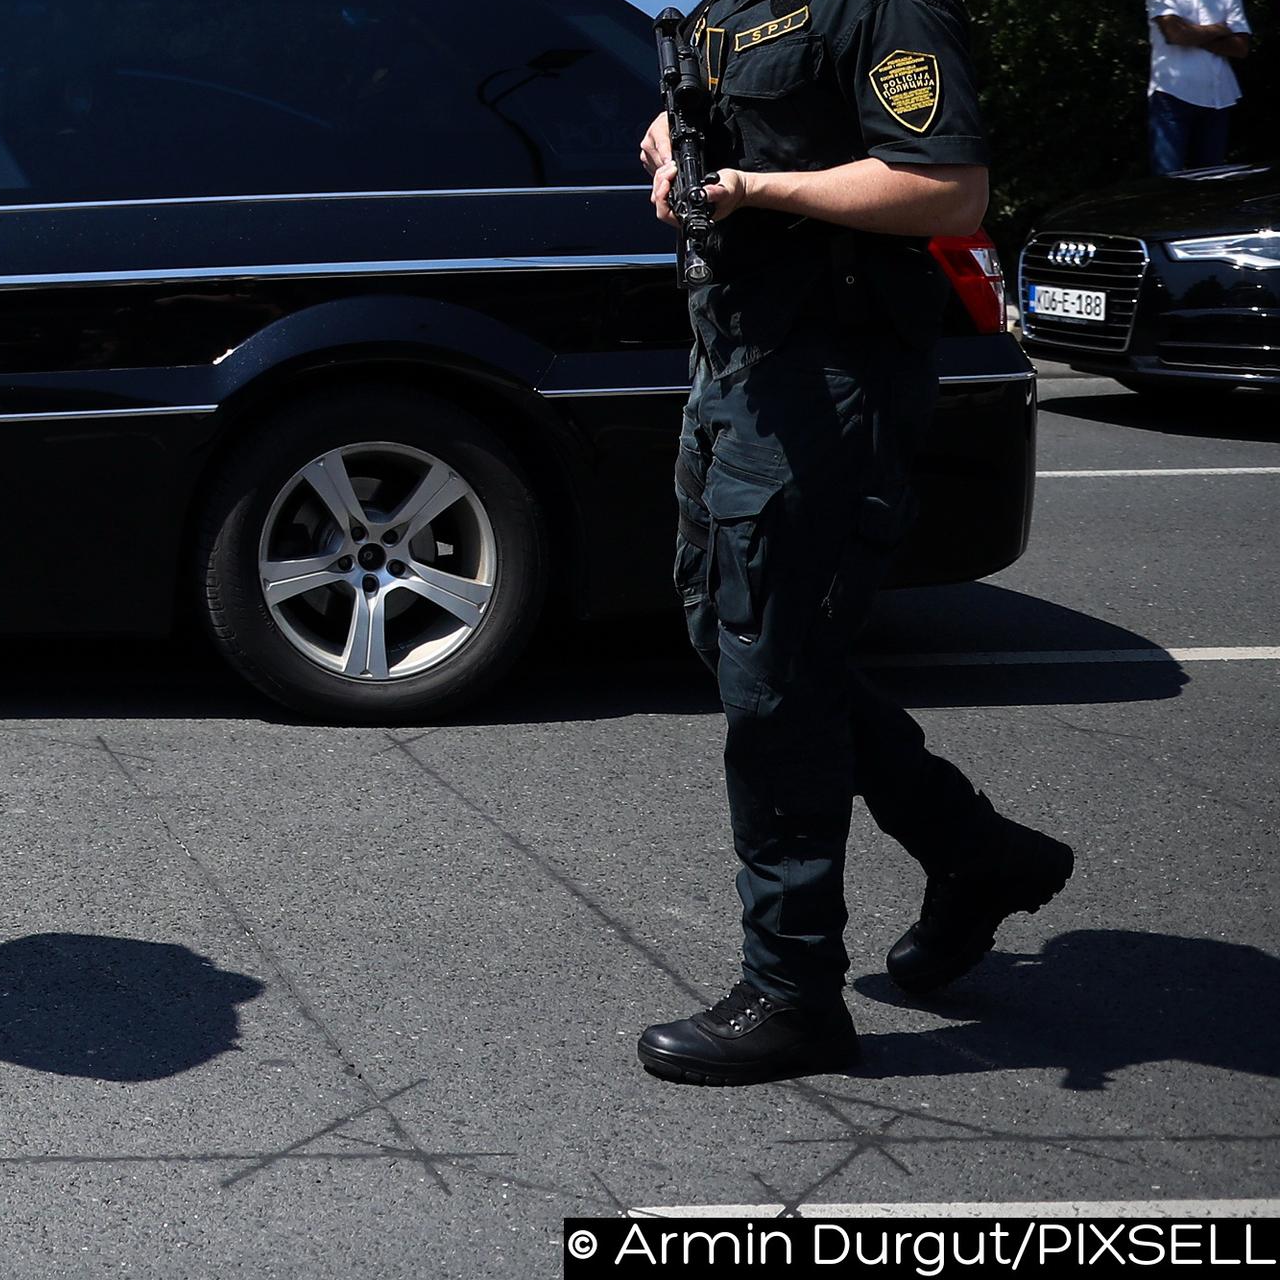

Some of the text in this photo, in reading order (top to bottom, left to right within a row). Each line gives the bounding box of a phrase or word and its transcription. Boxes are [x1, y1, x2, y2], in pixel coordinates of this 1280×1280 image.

[752, 17, 792, 41] SPJ
[883, 73, 930, 91] POLICIJA
[883, 79, 935, 98] ПОЛИЦИЈА
